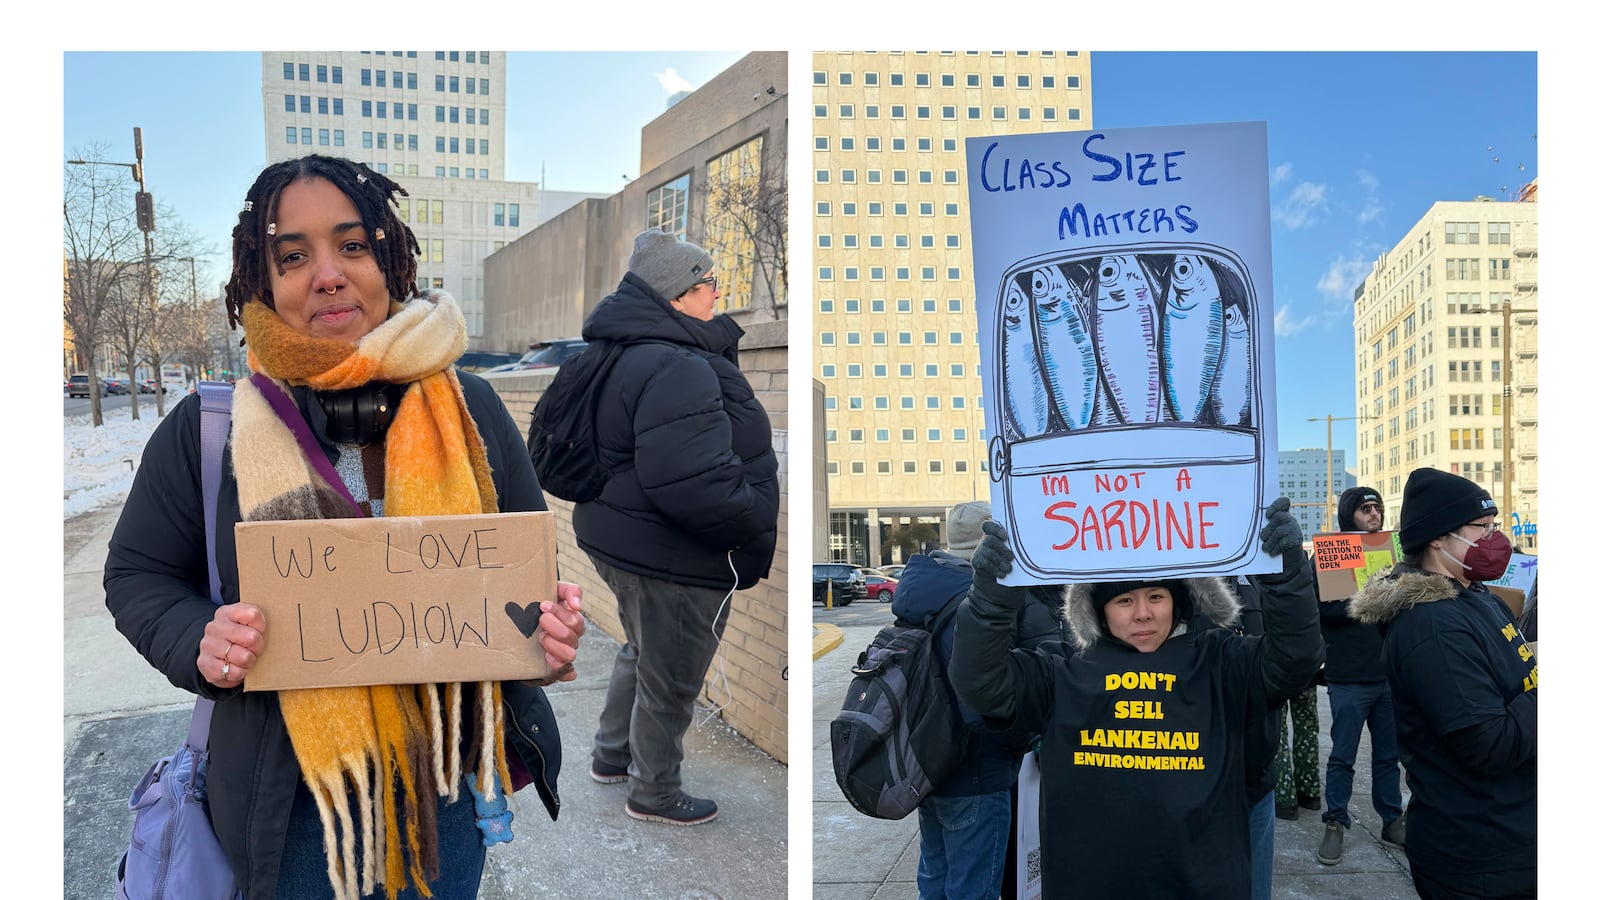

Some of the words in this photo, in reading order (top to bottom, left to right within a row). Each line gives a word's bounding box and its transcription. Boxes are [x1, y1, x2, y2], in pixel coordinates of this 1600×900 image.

[981, 142, 1072, 192] CLASS
[1082, 134, 1186, 186] SIZE
[1058, 202, 1199, 240] MATTERS
[1041, 474, 1070, 496] I'M
[1095, 471, 1146, 492] NOT
[1176, 468, 1192, 491] A
[1044, 499, 1220, 551] SARDINE
[386, 528, 505, 574] LOVE
[1317, 546, 1351, 554] PETITION
[1319, 554, 1338, 562] KEEP
[1320, 561, 1340, 569] OPEN
[1105, 671, 1177, 692] DON'T
[1114, 700, 1164, 720] SELL
[1080, 728, 1200, 751] LANKENAU
[1073, 751, 1206, 770] ENVIRONMENTAL
